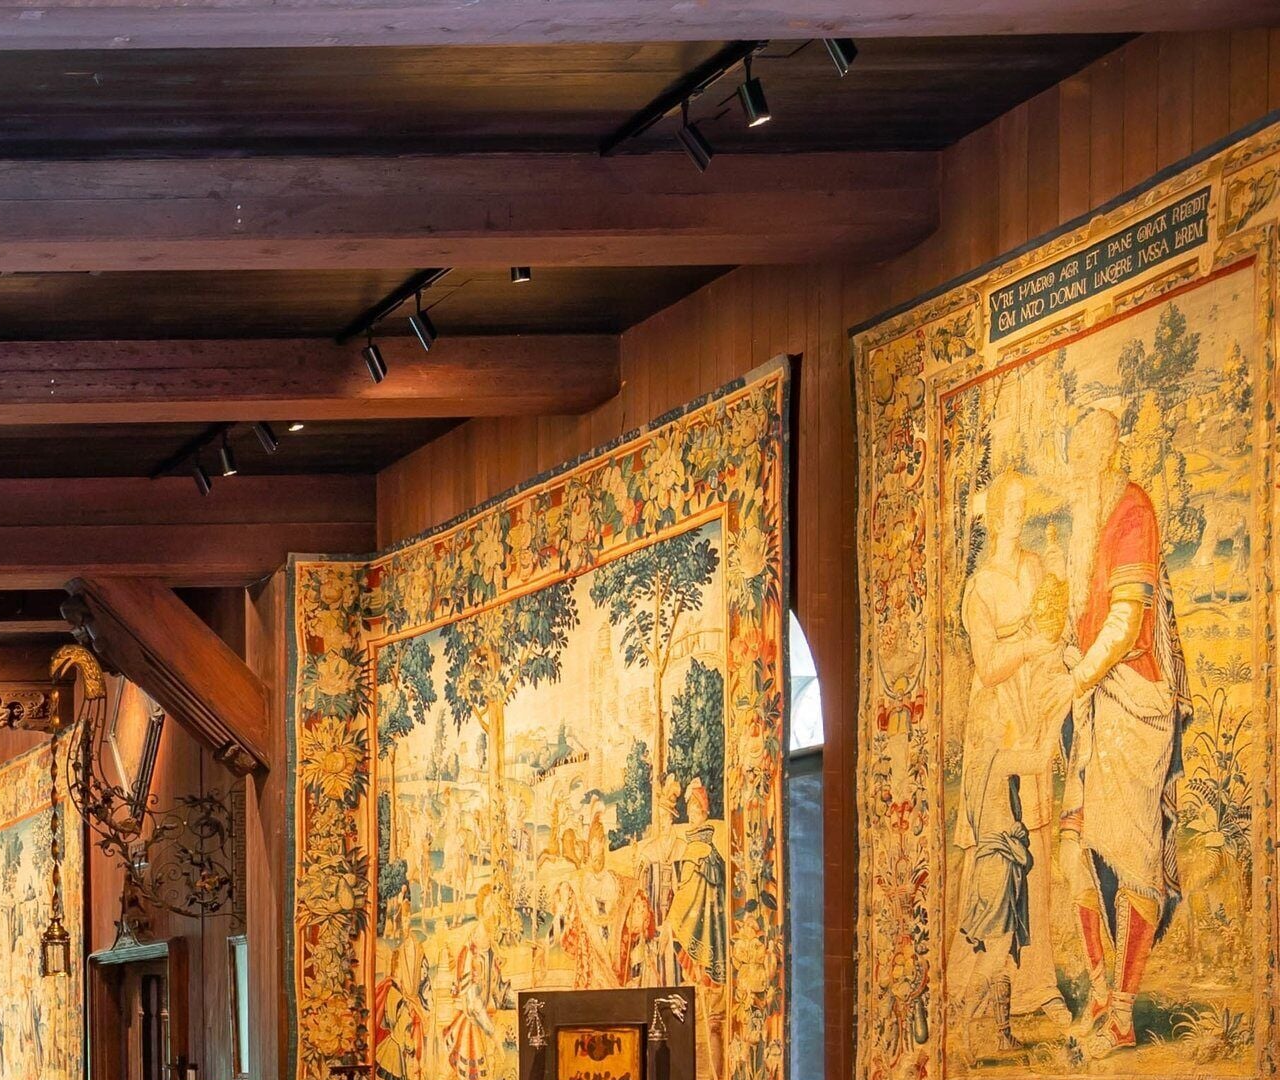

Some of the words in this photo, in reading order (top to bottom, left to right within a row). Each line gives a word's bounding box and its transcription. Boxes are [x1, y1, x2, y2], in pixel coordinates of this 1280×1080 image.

[1049, 277, 1087, 309] DOMINI
[1138, 238, 1169, 267] IVSSA
[1085, 250, 1100, 270] ET
[1107, 232, 1133, 258] PANE
